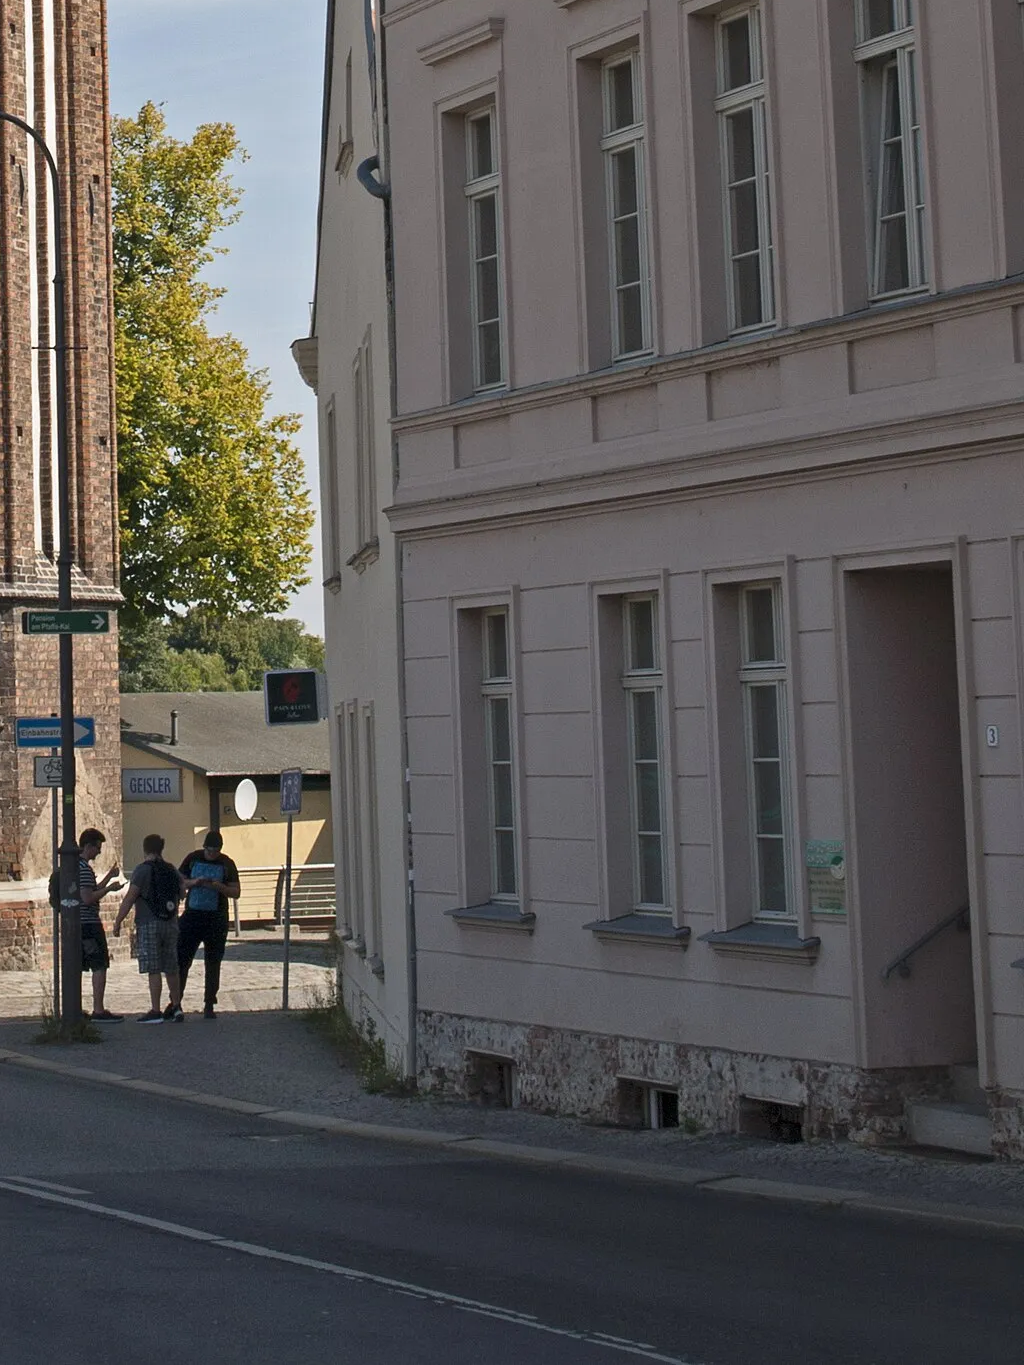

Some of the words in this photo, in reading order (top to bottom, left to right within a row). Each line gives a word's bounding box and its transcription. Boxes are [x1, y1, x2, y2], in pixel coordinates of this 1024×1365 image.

[21, 729, 61, 737] Einbahnstr
[989, 728, 996, 744] 3
[129, 777, 172, 794] GEISLER
